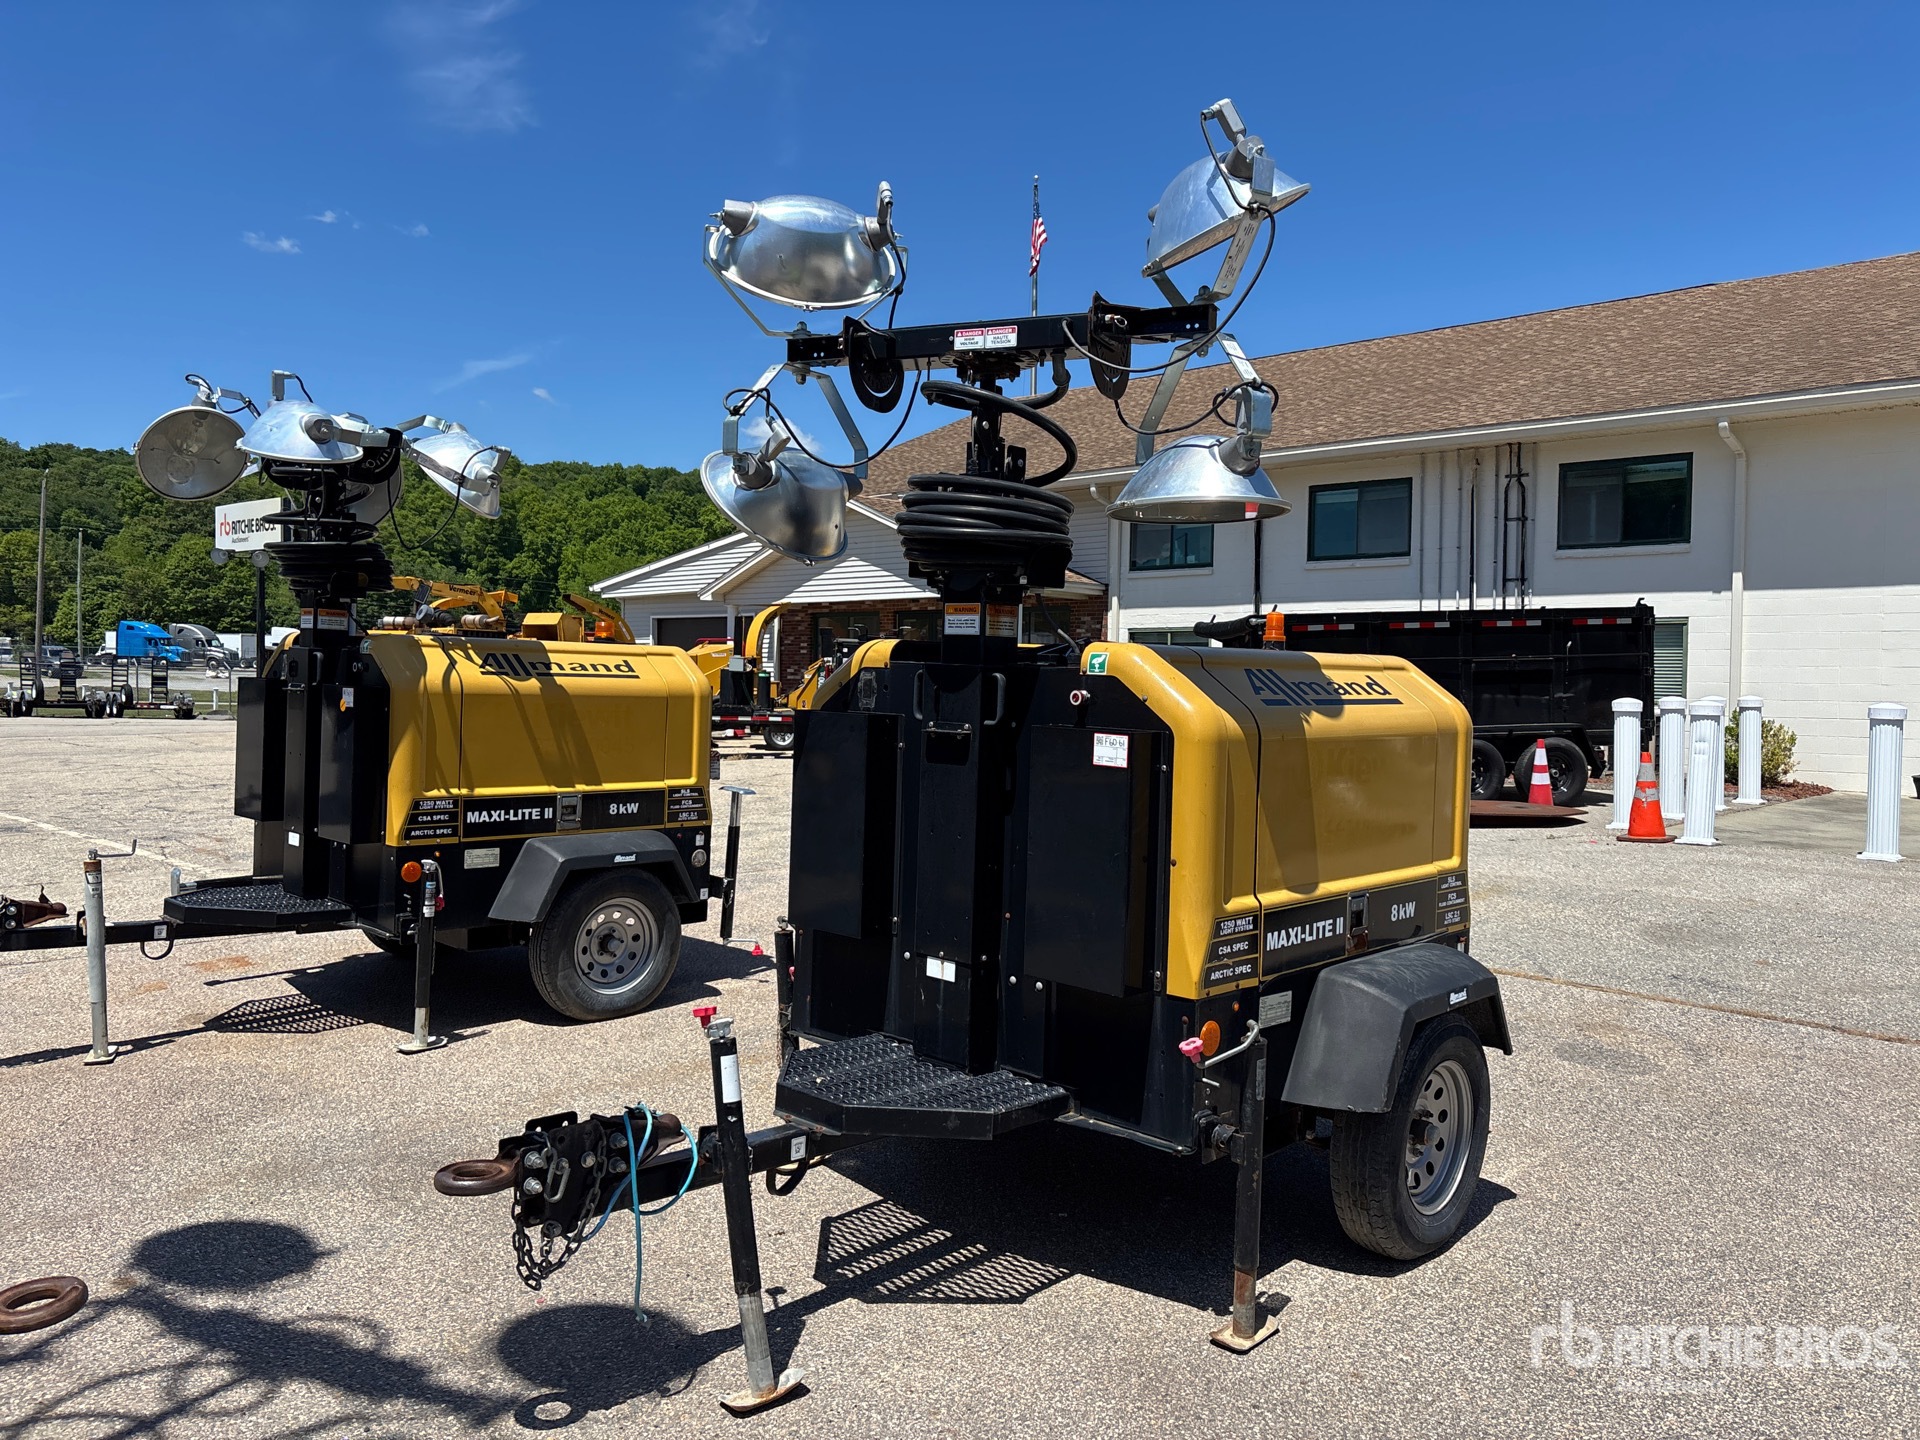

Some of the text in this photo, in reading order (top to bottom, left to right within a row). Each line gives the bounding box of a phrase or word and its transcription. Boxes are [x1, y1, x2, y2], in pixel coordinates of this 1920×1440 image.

[232, 519, 254, 535] RITCHIE
[449, 584, 476, 596] Vermeer
[479, 652, 638, 677] Allmand
[1244, 668, 1395, 706] Allmand
[467, 808, 541, 823] MAXI-LITE
[609, 803, 639, 815] 8 kW
[1391, 901, 1416, 922] 8 kW
[1220, 917, 1253, 930] 1250 WATT
[1220, 924, 1253, 935] LIGHT SYSTEM
[1266, 919, 1333, 951] MAXI-LITE
[1218, 941, 1249, 955] CSA SPEC
[1210, 964, 1252, 980] ARCTIC SPEC
